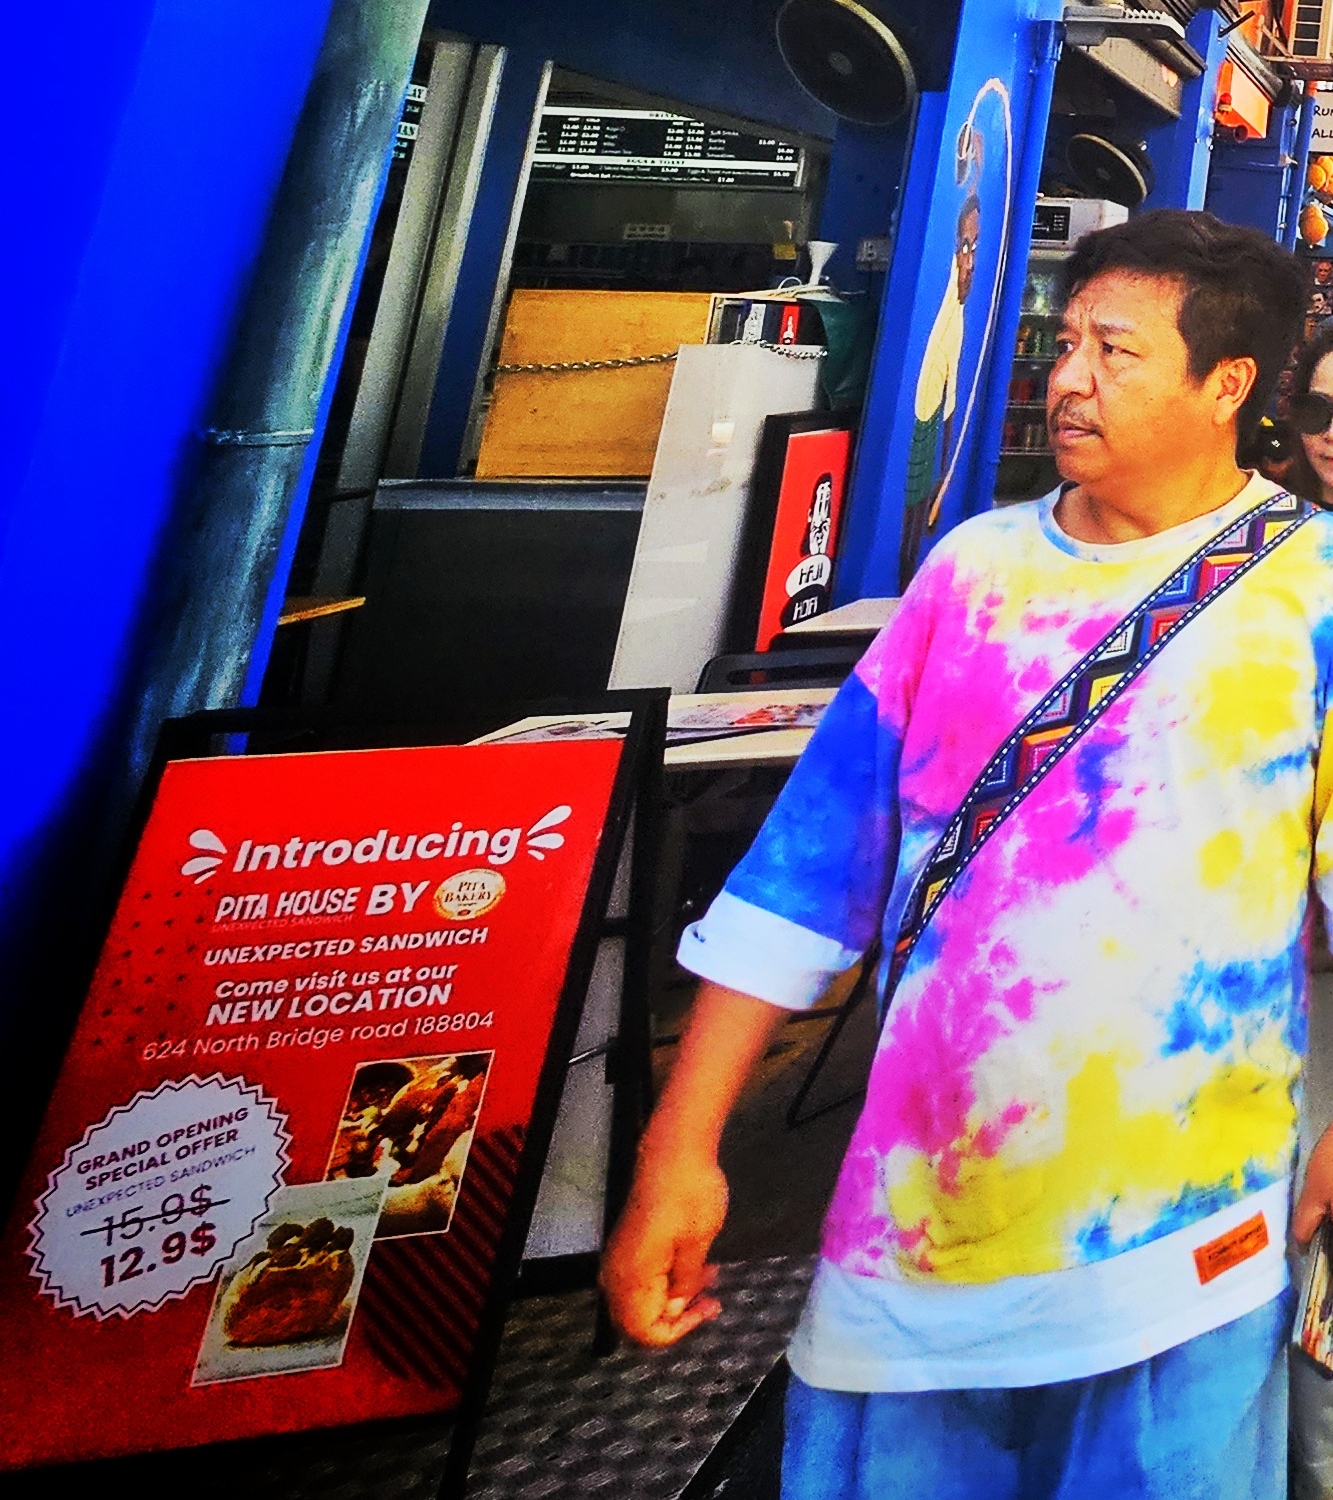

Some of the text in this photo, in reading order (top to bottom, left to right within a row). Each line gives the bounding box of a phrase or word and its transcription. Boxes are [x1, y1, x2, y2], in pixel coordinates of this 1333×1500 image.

[232, 822, 523, 873] Introducing
[214, 880, 431, 923] PITA HOUSE BY
[203, 927, 489, 966] UNEXPECTED SANDWICH
[205, 983, 452, 1027] NEW LOCATION
[215, 964, 459, 998] Come visit us at our
[142, 1010, 495, 1061] 624 North Bridge road 188804
[77, 1107, 249, 1175] GRAND OPENING
[85, 1128, 239, 1190] SPECIAL OFFER
[102, 1183, 213, 1247] 15.9$
[100, 1221, 217, 1288] 12.9$
